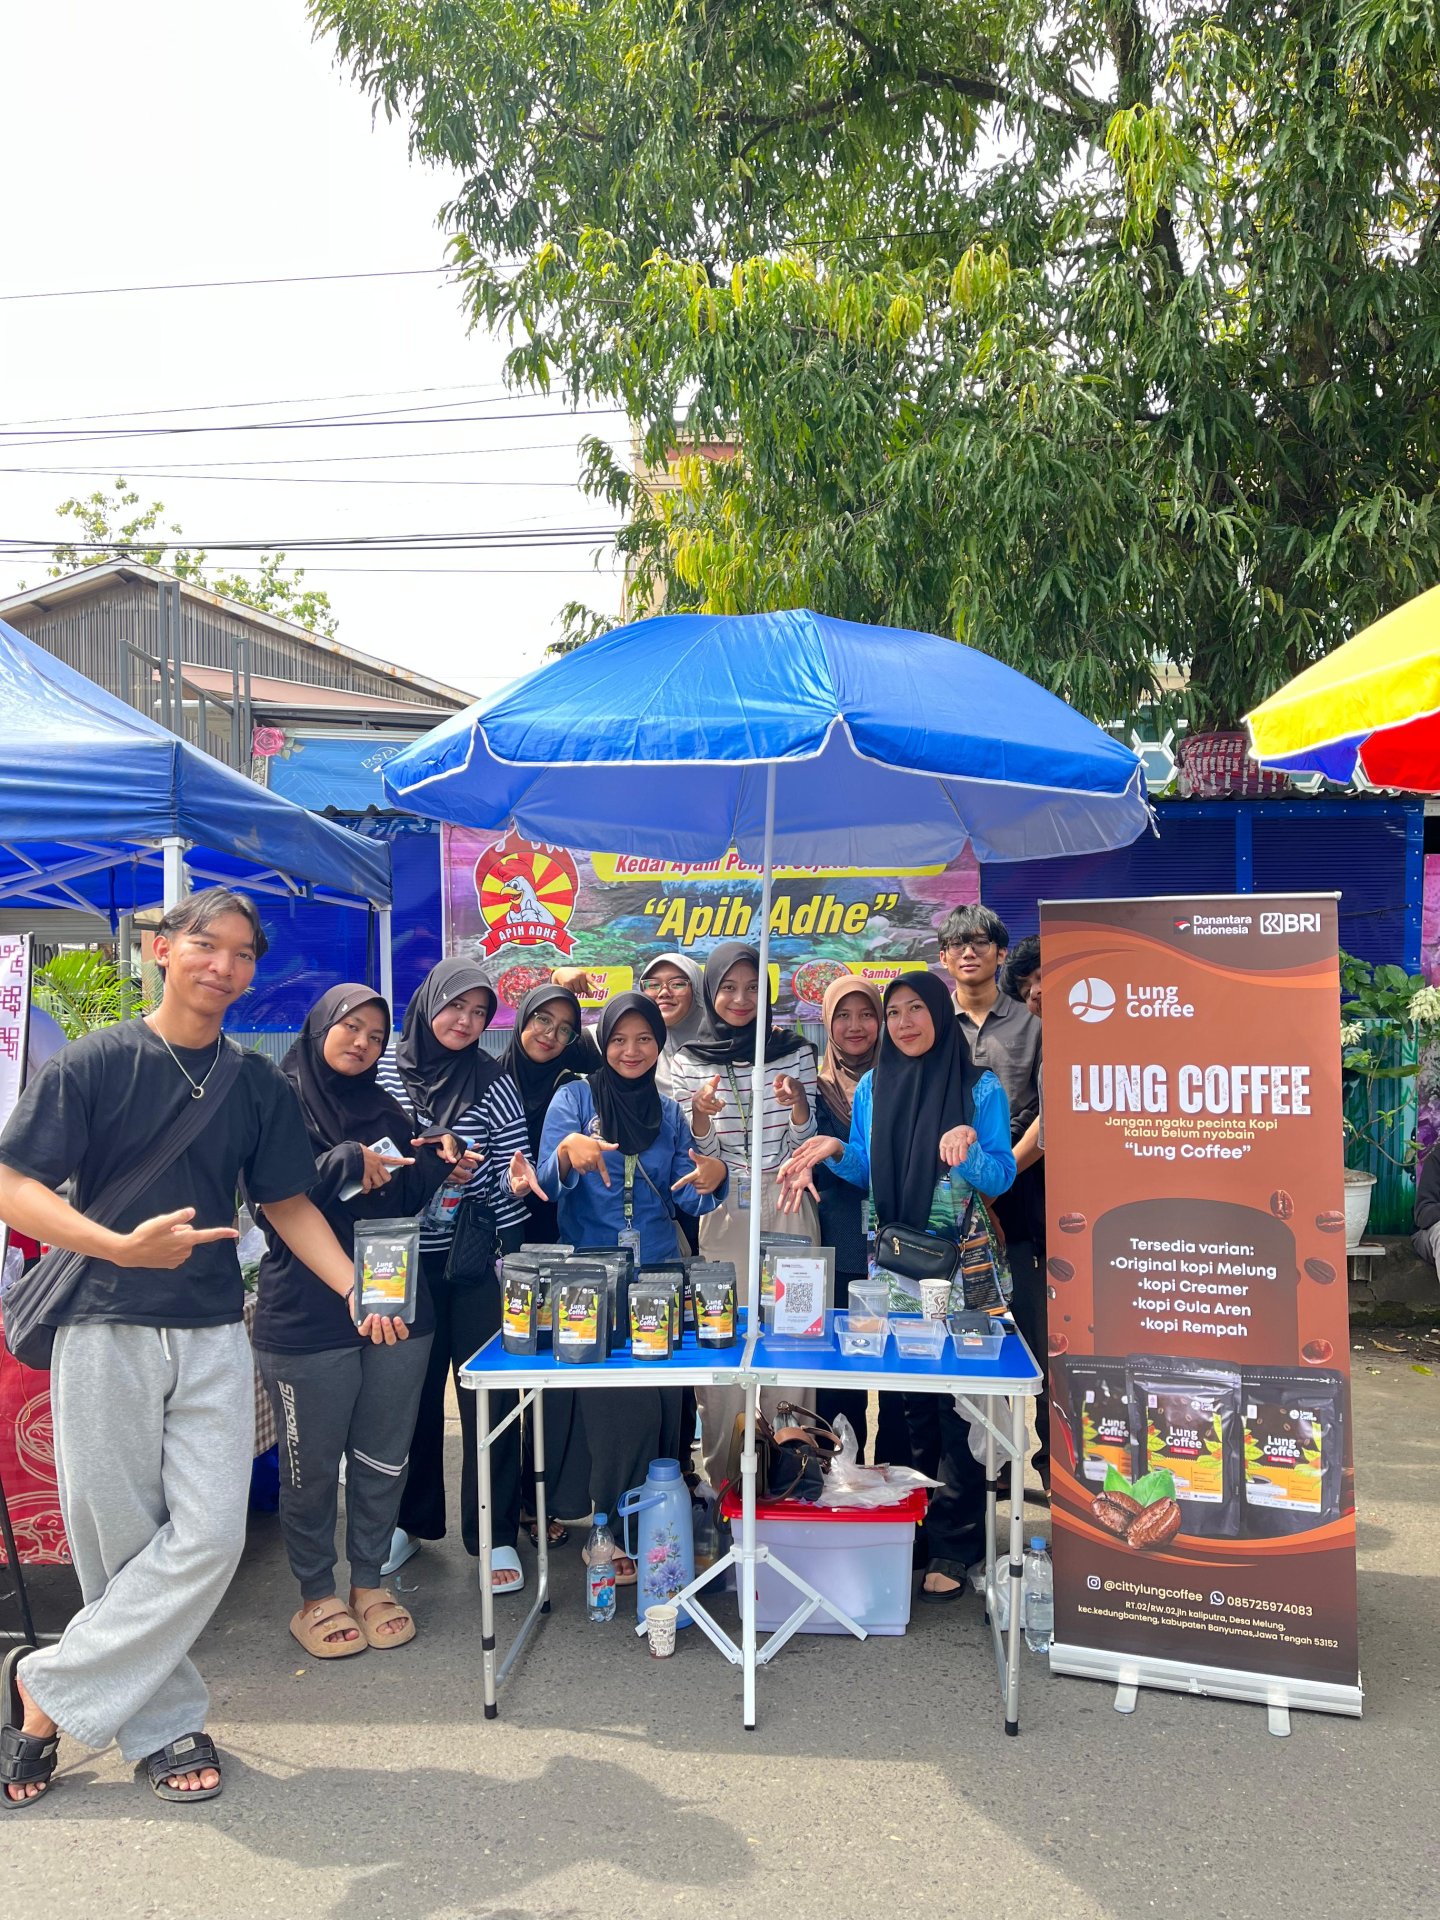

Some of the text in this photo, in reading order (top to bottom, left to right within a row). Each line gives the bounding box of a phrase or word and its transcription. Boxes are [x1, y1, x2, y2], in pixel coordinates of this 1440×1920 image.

[643, 893, 898, 946] “Apih Adhe”
[1193, 913, 1320, 933] Danantara BRI
[498, 925, 558, 941] APIH ADHE
[1193, 925, 1249, 935] Indonesia
[1126, 983, 1178, 1003] Lung
[1126, 1000, 1195, 1018] Coffee
[1071, 1064, 1312, 1115] LUNG COFFEE
[1105, 1117, 1278, 1131] Jangan ngaku pecinta Kopi
[1124, 1127, 1255, 1141] kalau belum nyobain
[1125, 1142, 1251, 1160] “Lung Coffee”
[1130, 1238, 1255, 1256] Tersedia varian:
[1180, 1260, 1213, 1276] kopi
[1217, 1262, 1277, 1280] Melung
[1179, 1280, 1249, 1296] Creamer
[1173, 1300, 1211, 1314] Gula
[1214, 1302, 1252, 1317] Aren
[1182, 1320, 1248, 1337] Rempah
[1097, 1426, 1130, 1438] Coffee
[1101, 1417, 1126, 1430] Lung
[1165, 1435, 1203, 1449] Coffee
[1169, 1426, 1198, 1441] Lung
[1267, 1435, 1297, 1449] Lung
[1263, 1445, 1301, 1458] Coffee
[1104, 1580, 1313, 1617] @cittylungcoffee 085725974083
[1078, 1604, 1160, 1625] kec.kedungbanteng,
[1161, 1616, 1207, 1631] kabupaten
[1279, 1633, 1313, 1646] Tengah
[1313, 1637, 1339, 1648] 53152
[1188, 1609, 1228, 1624] kaliputra,
[1229, 1615, 1251, 1626] Desa
[1252, 1618, 1286, 1632] Melung,
